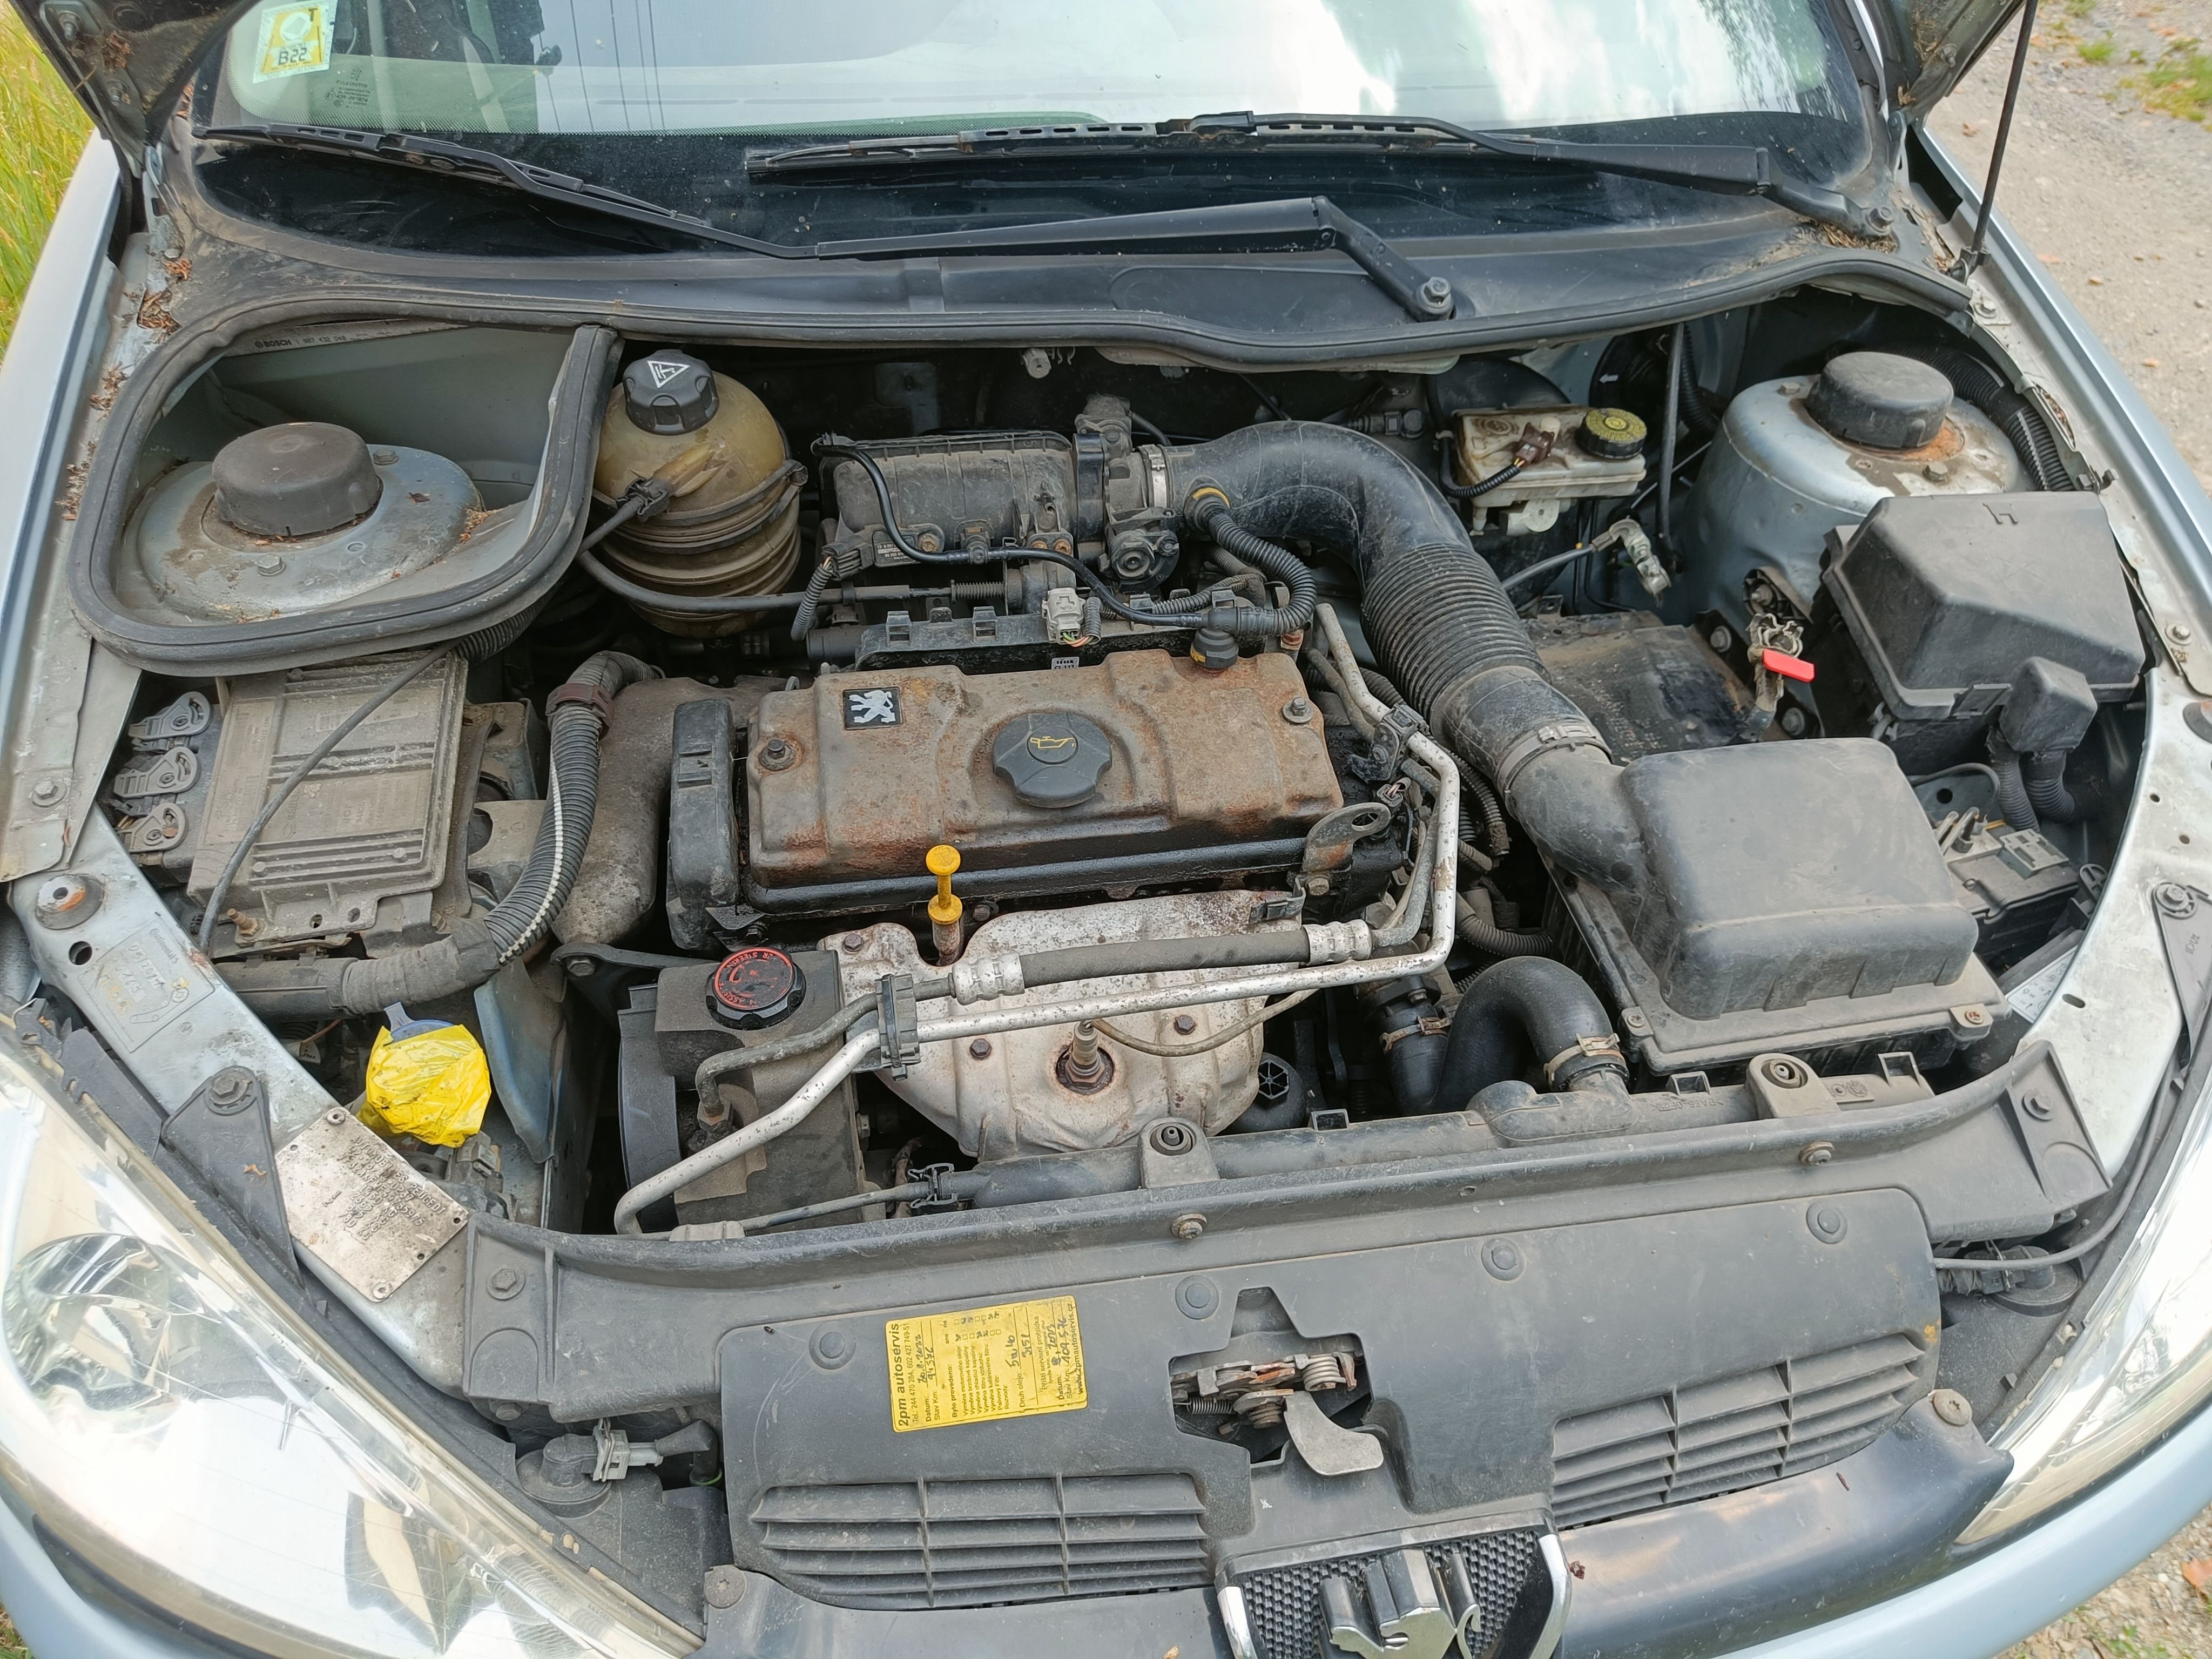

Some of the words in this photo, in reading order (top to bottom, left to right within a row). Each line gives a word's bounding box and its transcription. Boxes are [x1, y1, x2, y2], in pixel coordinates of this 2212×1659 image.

[279, 48, 307, 65] B22
[263, 339, 292, 348] BOSCH
[214, 791, 232, 819] PSA
[148, 927, 177, 961] Continental
[349, 1190, 375, 1213] 2365
[373, 1210, 390, 1226] KG
[381, 1203, 398, 1219] KG
[407, 1181, 446, 1216] PEUGEOT
[337, 1210, 358, 1229] 780
[356, 1225, 373, 1242] KG
[365, 1218, 382, 1233] KG
[943, 1319, 948, 1327] ne
[1034, 1316, 1042, 1345] prohlídka
[891, 1323, 905, 1394] autoservis
[1037, 1346, 1045, 1371] servisní
[948, 1364, 956, 1401] provedeno:
[897, 1397, 910, 1427] 2pm
